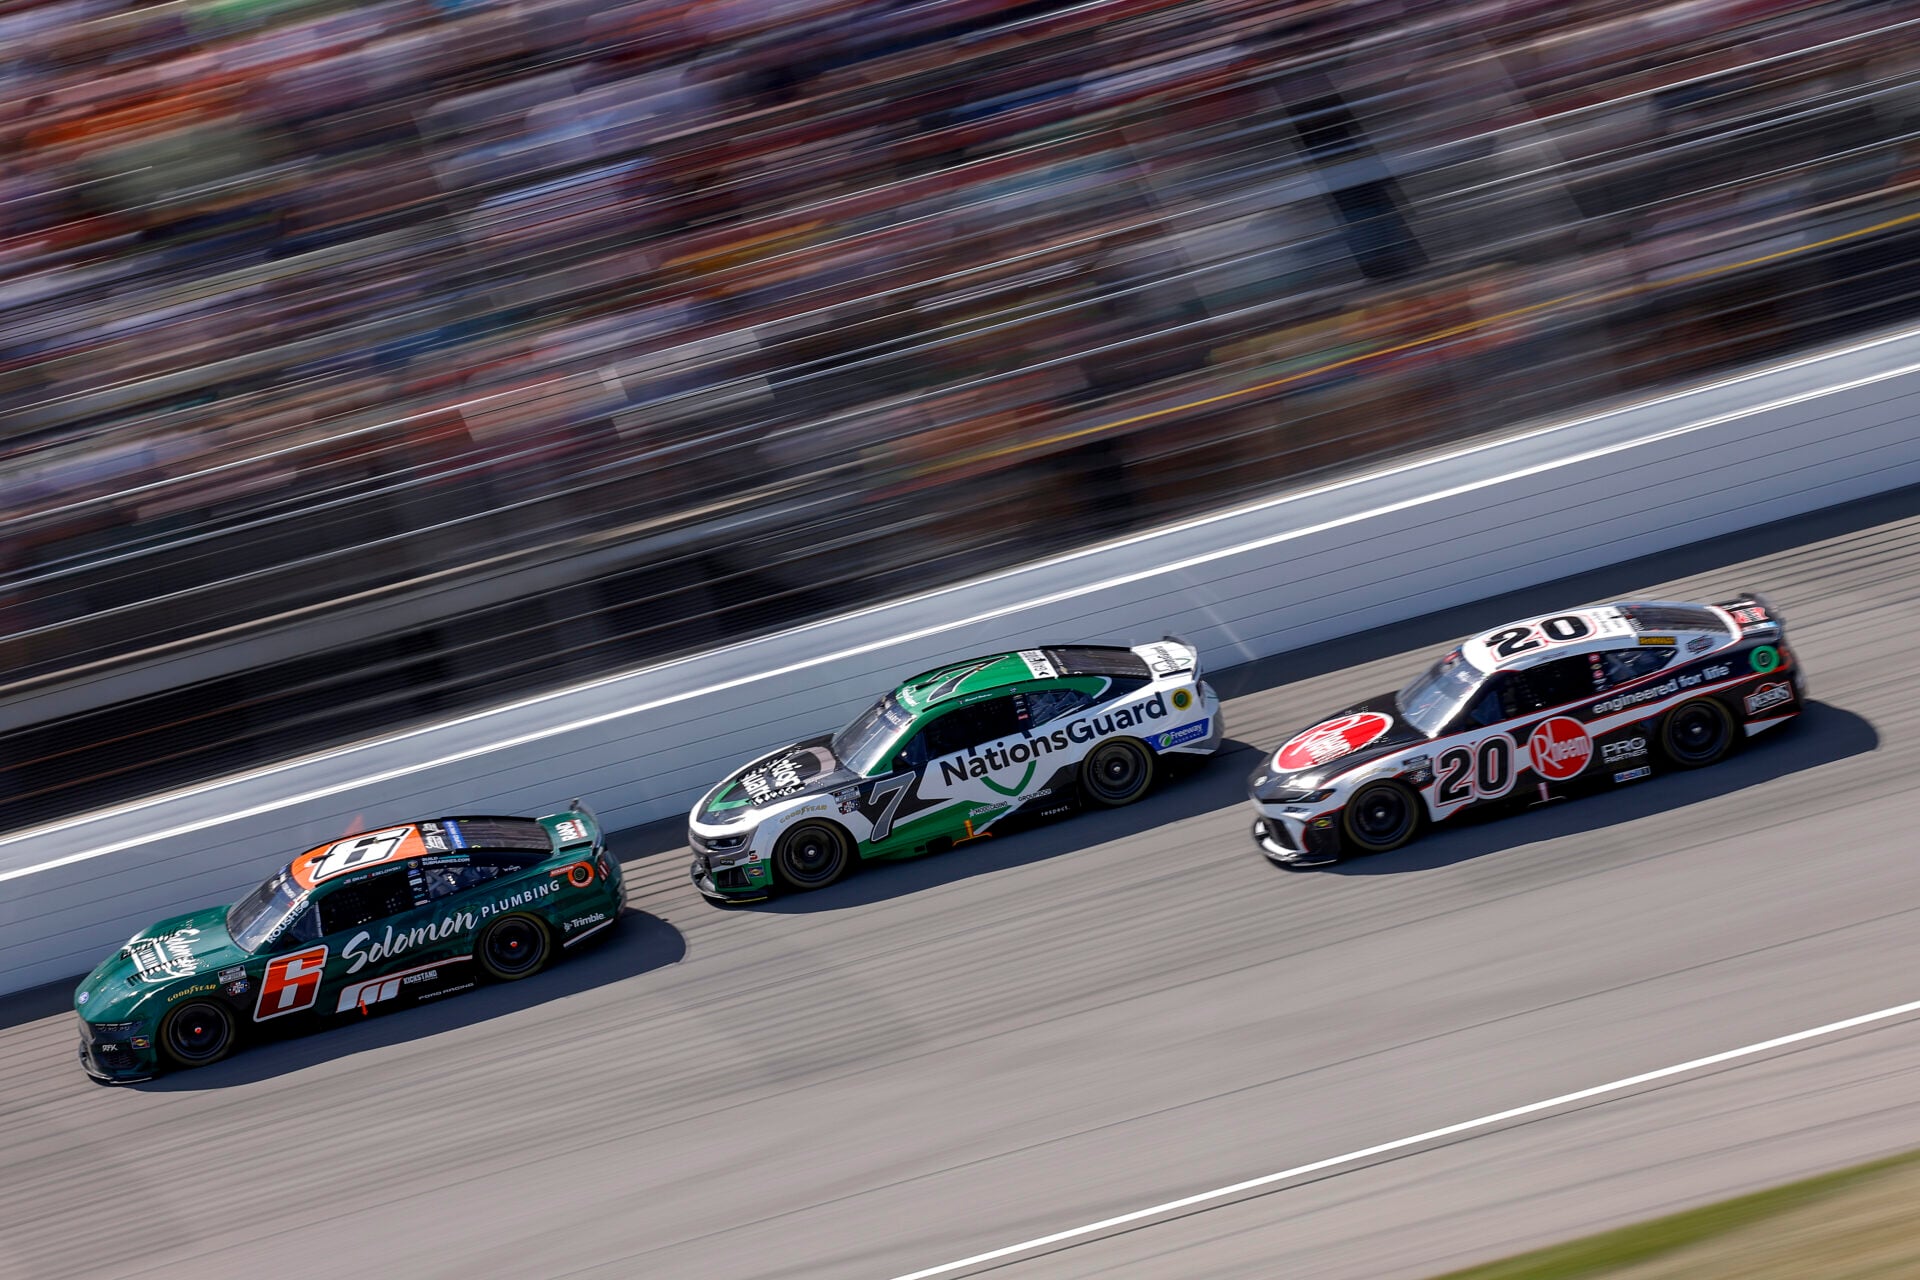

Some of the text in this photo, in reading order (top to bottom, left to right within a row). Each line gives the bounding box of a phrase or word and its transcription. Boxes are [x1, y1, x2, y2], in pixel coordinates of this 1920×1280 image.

[1486, 615, 1590, 658] 20
[926, 655, 1010, 703] 7
[1592, 680, 1679, 714] engineered
[1679, 671, 1702, 687] for
[939, 691, 1168, 786] NationsGuard
[1171, 723, 1204, 740] Freeway
[1533, 722, 1591, 772] Rheem
[1602, 737, 1647, 757] PRO
[1436, 734, 1515, 806] 20
[1604, 748, 1649, 763] PARTNER
[779, 805, 828, 823] GOODYEAR
[868, 771, 917, 843] 7
[309, 825, 416, 882] 6
[422, 858, 470, 866] SUBMARINES.COM
[341, 880, 560, 974] Solomon PLUMBING
[571, 912, 605, 928] Trimble
[167, 984, 217, 1002] GOODYEAR
[253, 945, 329, 1023] 6
[403, 969, 438, 984] KICKSTAND
